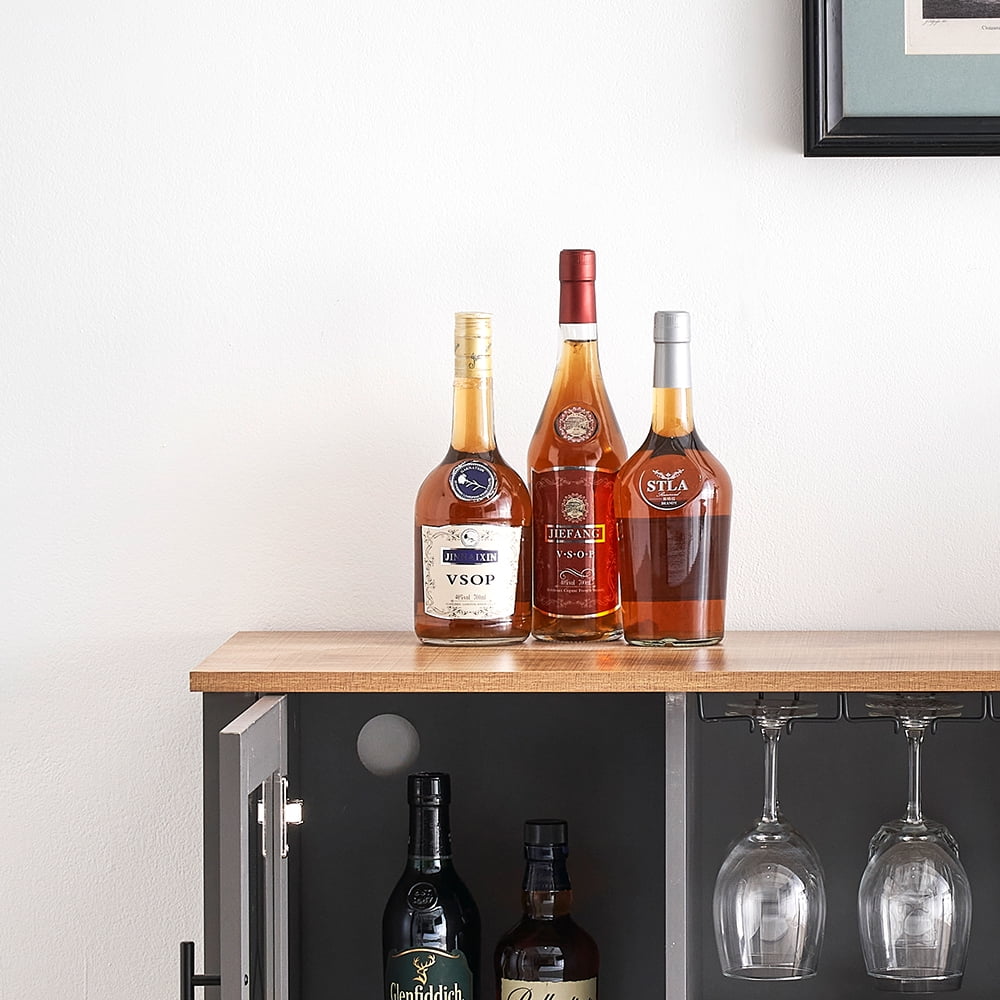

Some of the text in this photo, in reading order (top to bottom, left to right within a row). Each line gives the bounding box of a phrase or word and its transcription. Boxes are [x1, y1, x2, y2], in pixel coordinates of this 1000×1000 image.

[646, 479, 689, 492] STLA
[548, 528, 600, 539] JIEFANG
[446, 574, 495, 586] VSOP
